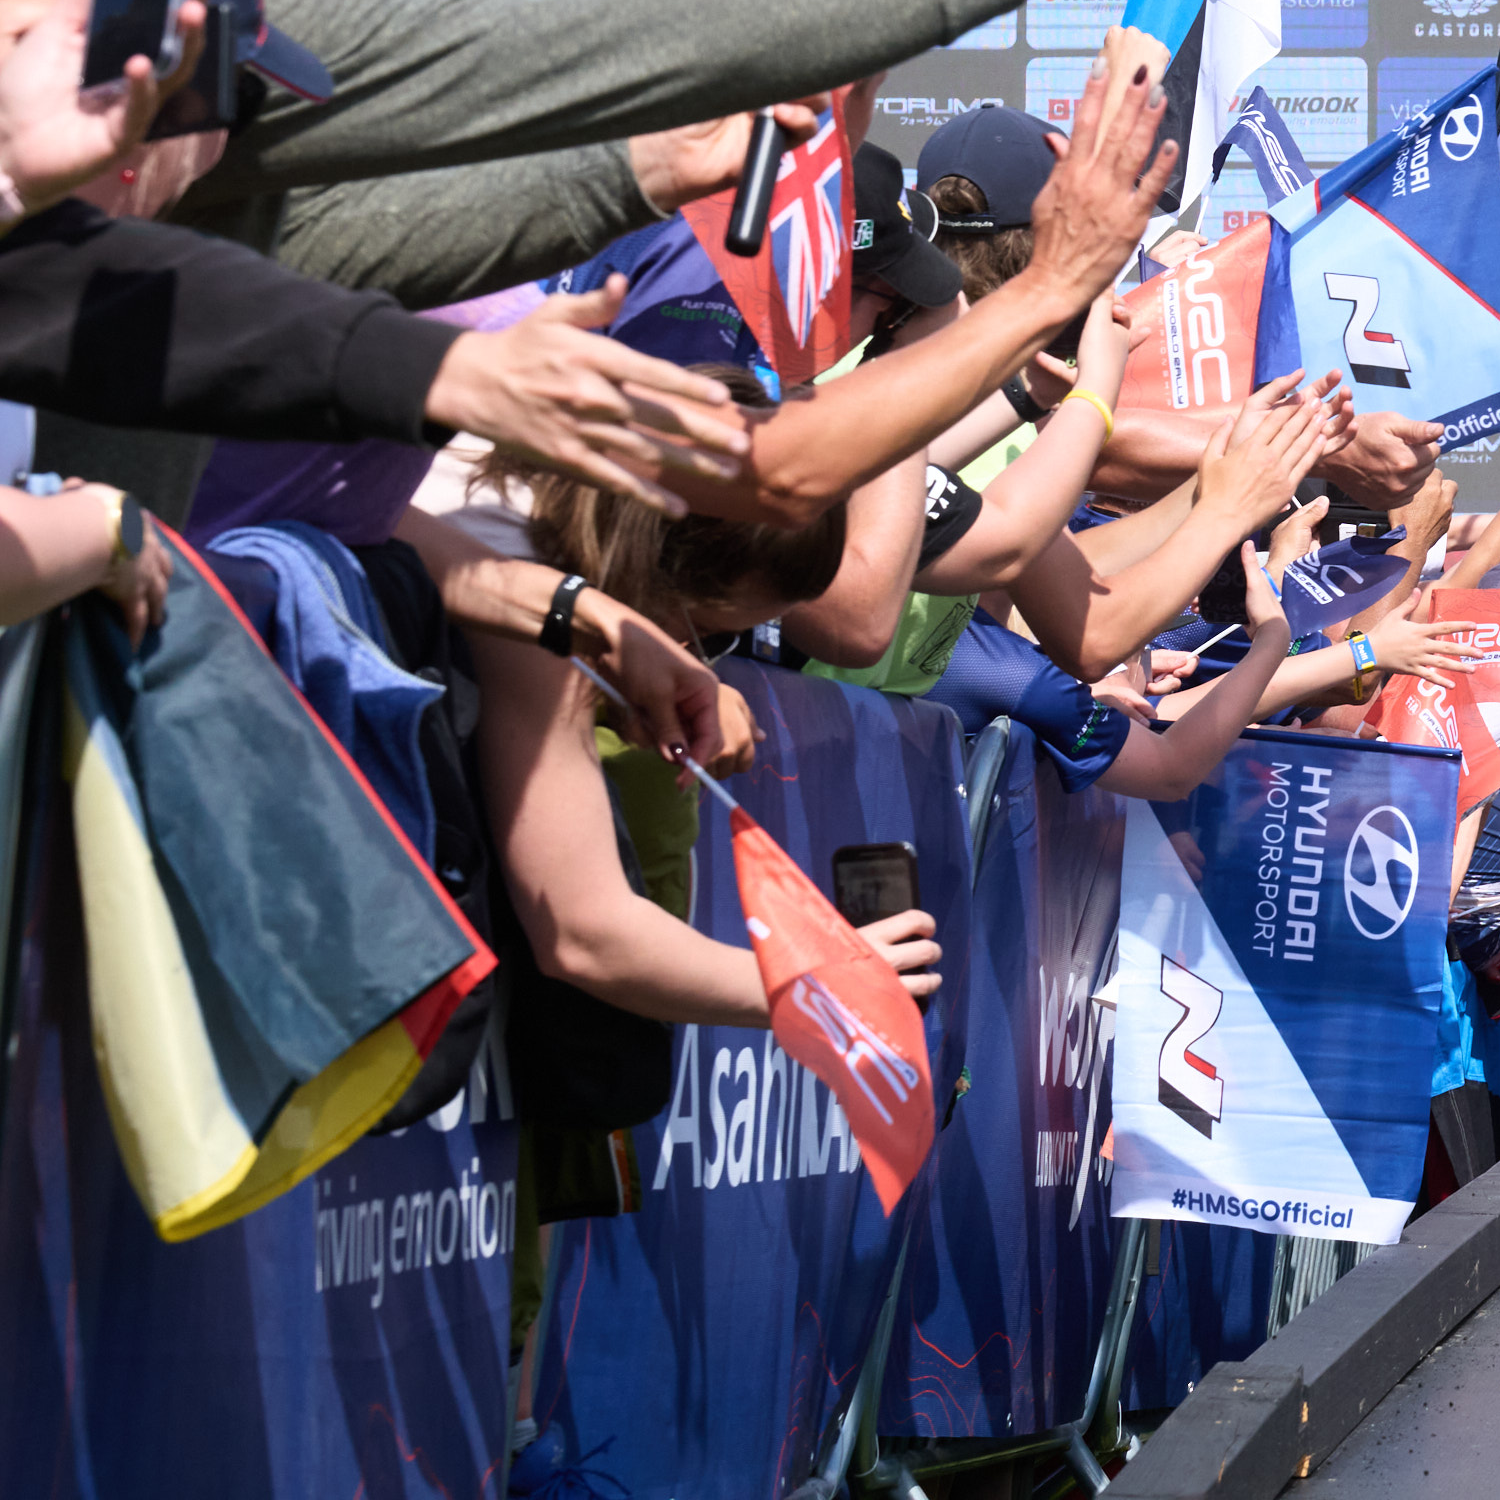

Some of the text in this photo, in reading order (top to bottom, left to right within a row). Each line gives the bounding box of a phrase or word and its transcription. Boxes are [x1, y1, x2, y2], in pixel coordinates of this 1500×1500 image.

[1252, 761, 1293, 959] MOTORSPORT
[1283, 765, 1333, 963] HYUNDAI
[389, 1156, 517, 1275] emotion
[1171, 1187, 1355, 1231] #HMSGOfficial
